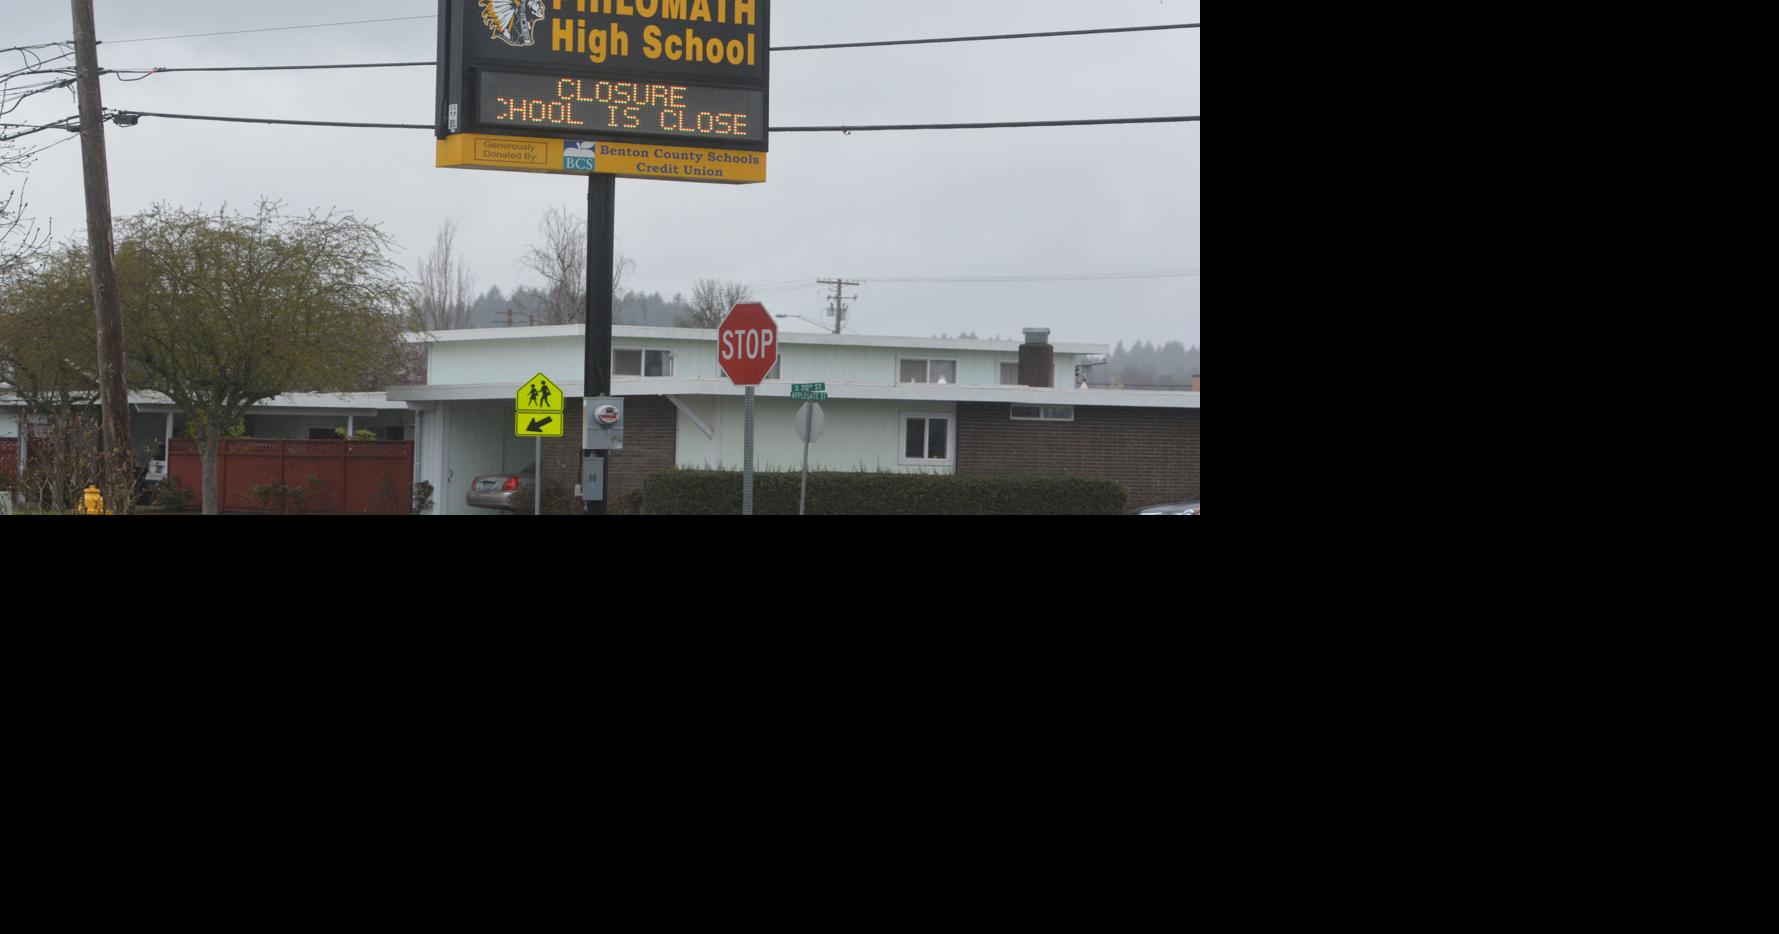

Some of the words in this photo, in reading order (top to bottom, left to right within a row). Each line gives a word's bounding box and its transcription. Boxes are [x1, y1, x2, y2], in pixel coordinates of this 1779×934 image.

[553, 0, 756, 25] LOMATH
[552, 18, 629, 63] High
[643, 25, 755, 65] School
[558, 78, 688, 107] CLOSURE
[607, 105, 640, 129] IS
[660, 109, 748, 136] CLOSE
[483, 141, 536, 152] Generously
[483, 150, 522, 160] Donated
[600, 145, 649, 158] Benton
[654, 149, 703, 163] County
[707, 152, 760, 165] Schools
[566, 157, 594, 170] BCS
[636, 162, 680, 175] Credit
[684, 165, 724, 177] Union
[722, 329, 774, 360] STOP
